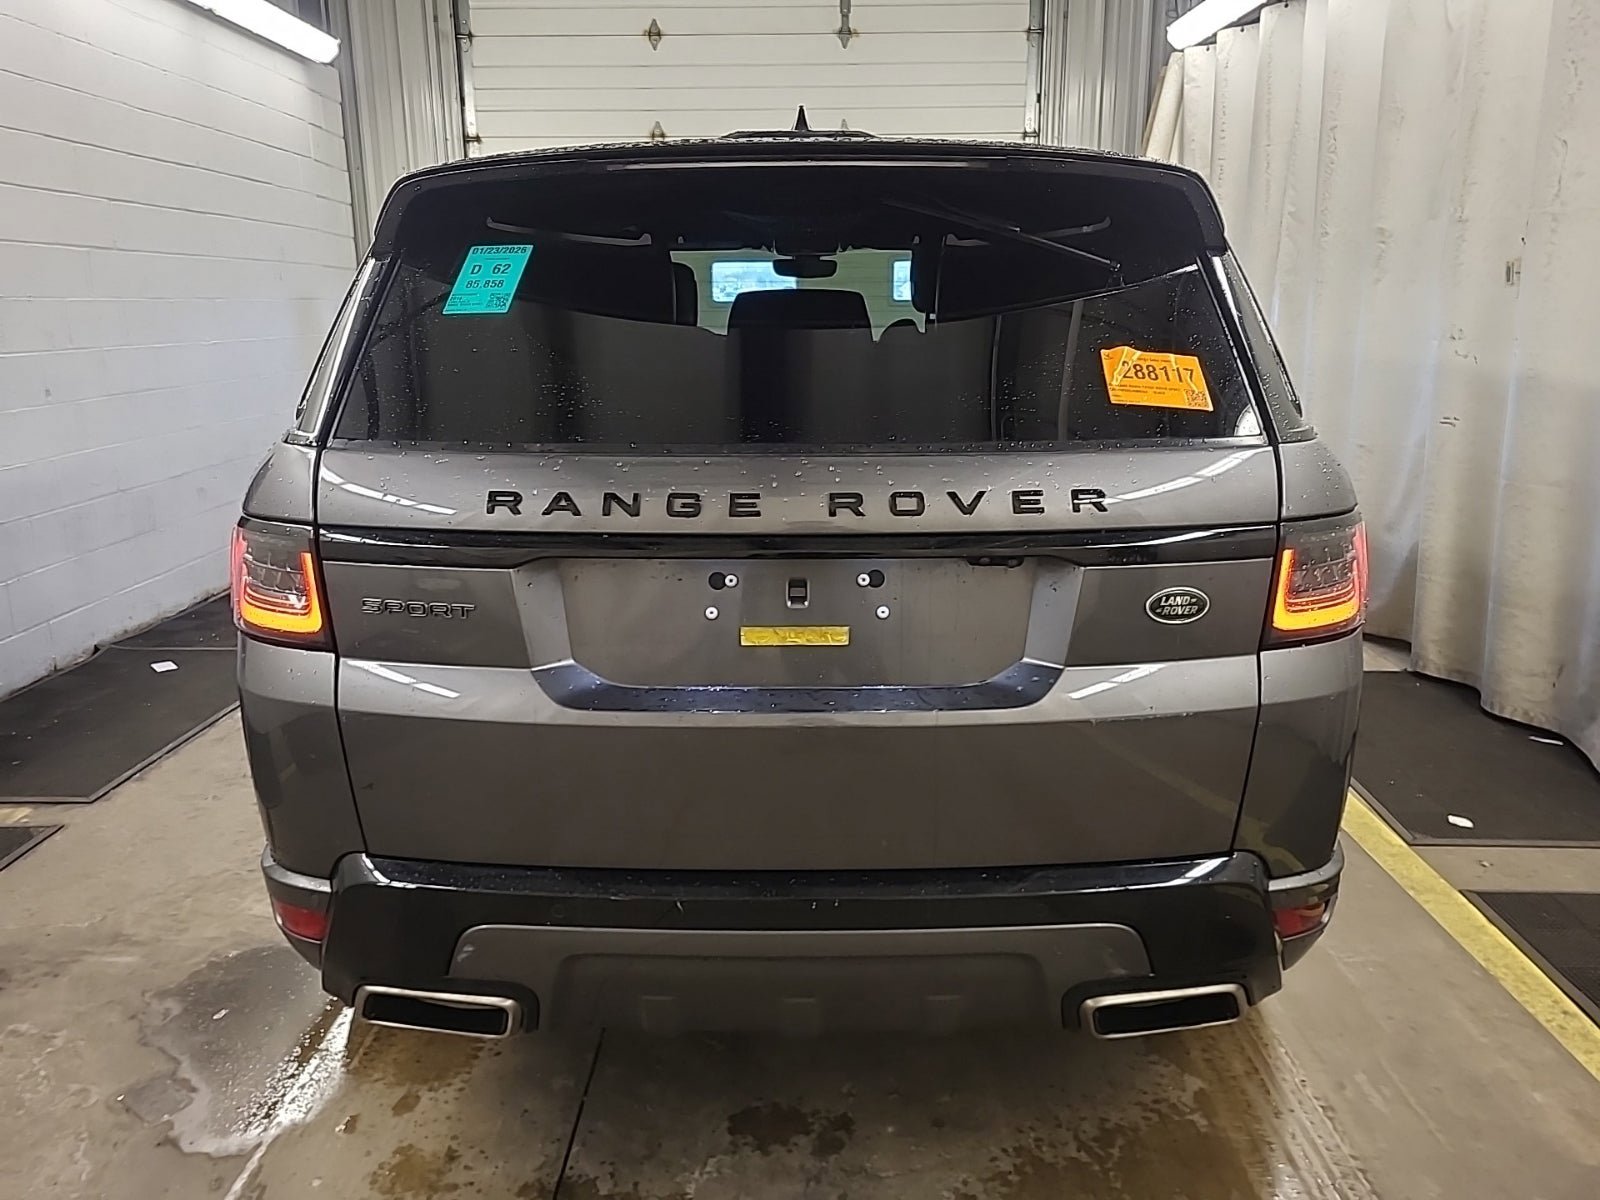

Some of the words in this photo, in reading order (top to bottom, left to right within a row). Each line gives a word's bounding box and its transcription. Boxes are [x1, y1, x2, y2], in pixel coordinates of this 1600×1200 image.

[472, 246, 527, 255] 01/23/2026
[470, 264, 482, 275] D
[492, 263, 511, 275] 62
[1122, 361, 1194, 383] 288117
[486, 490, 762, 517] RANGE
[828, 488, 1109, 517] ROVER
[1160, 596, 1190, 605] LAND
[361, 598, 475, 619] SPORT
[1161, 605, 1198, 615] ROVER
